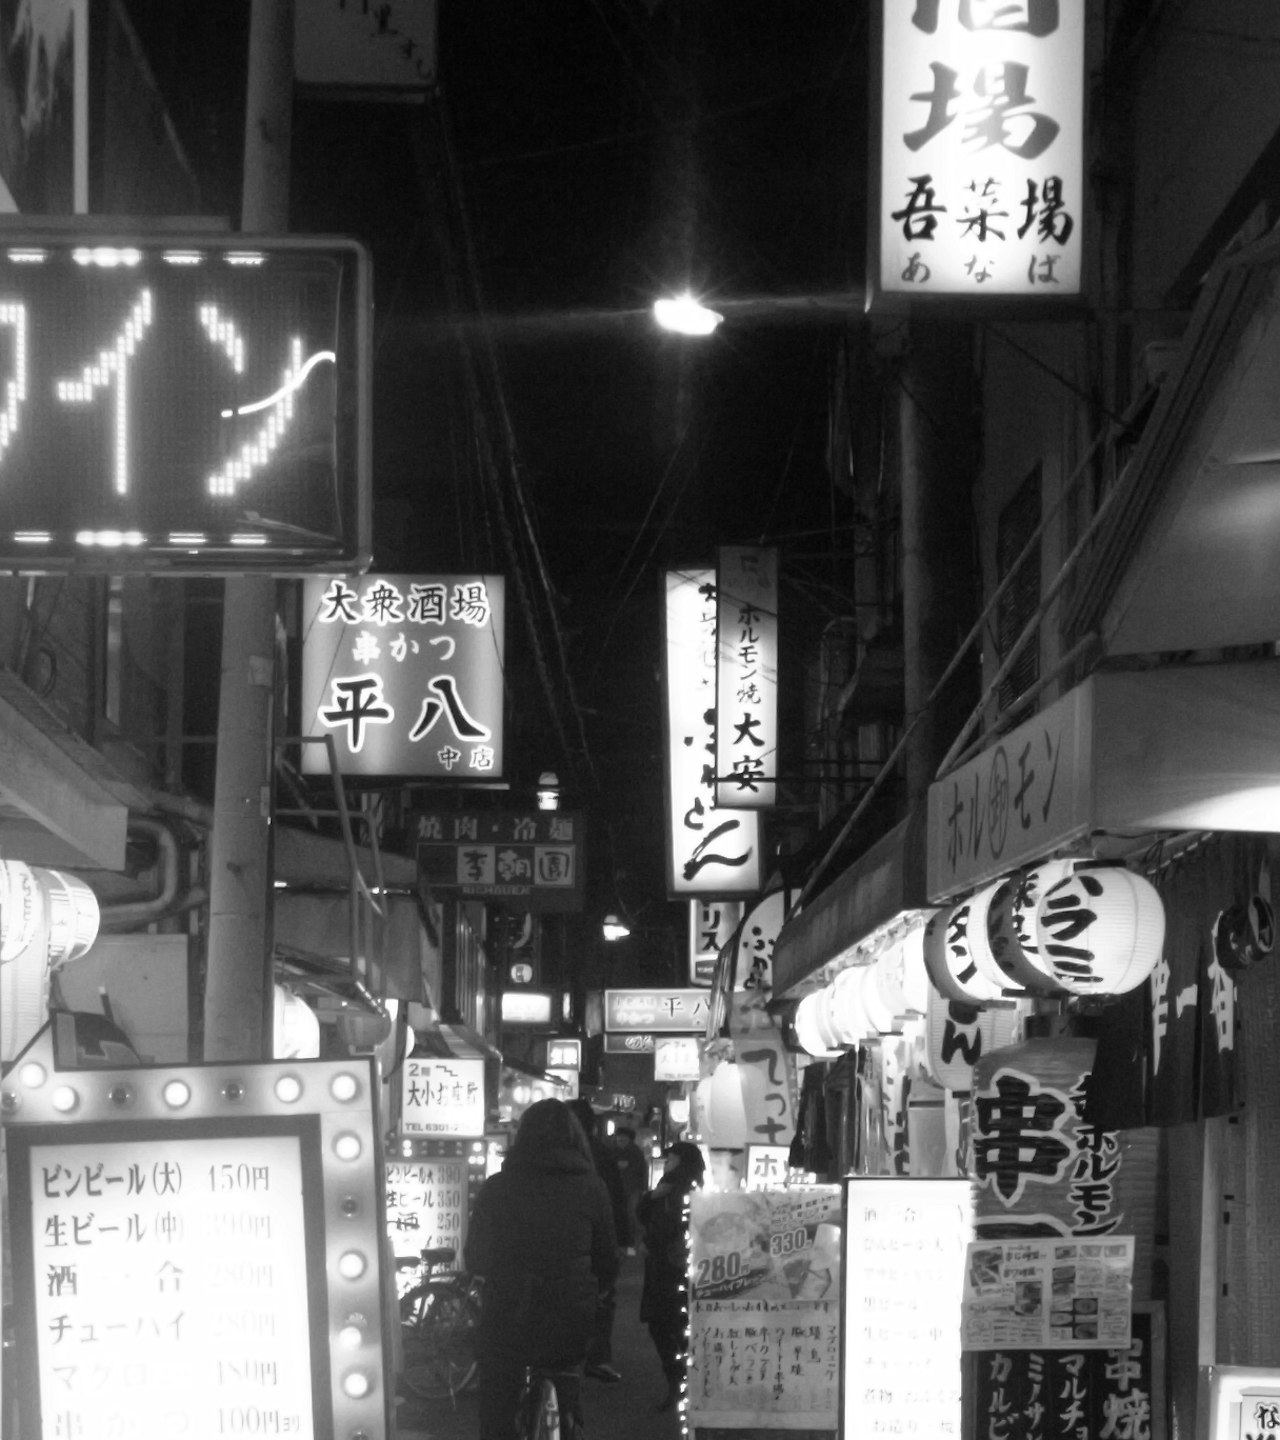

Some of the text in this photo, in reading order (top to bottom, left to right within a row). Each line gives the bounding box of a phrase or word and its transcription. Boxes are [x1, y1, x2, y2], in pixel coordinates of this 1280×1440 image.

[901, 252, 1061, 284] あなば
[323, 582, 488, 626] 大衆酒場
[352, 630, 456, 666] 串かつ
[321, 674, 490, 751] 平八
[732, 712, 765, 793] 大安
[48, 1310, 185, 1345] チューハイ
